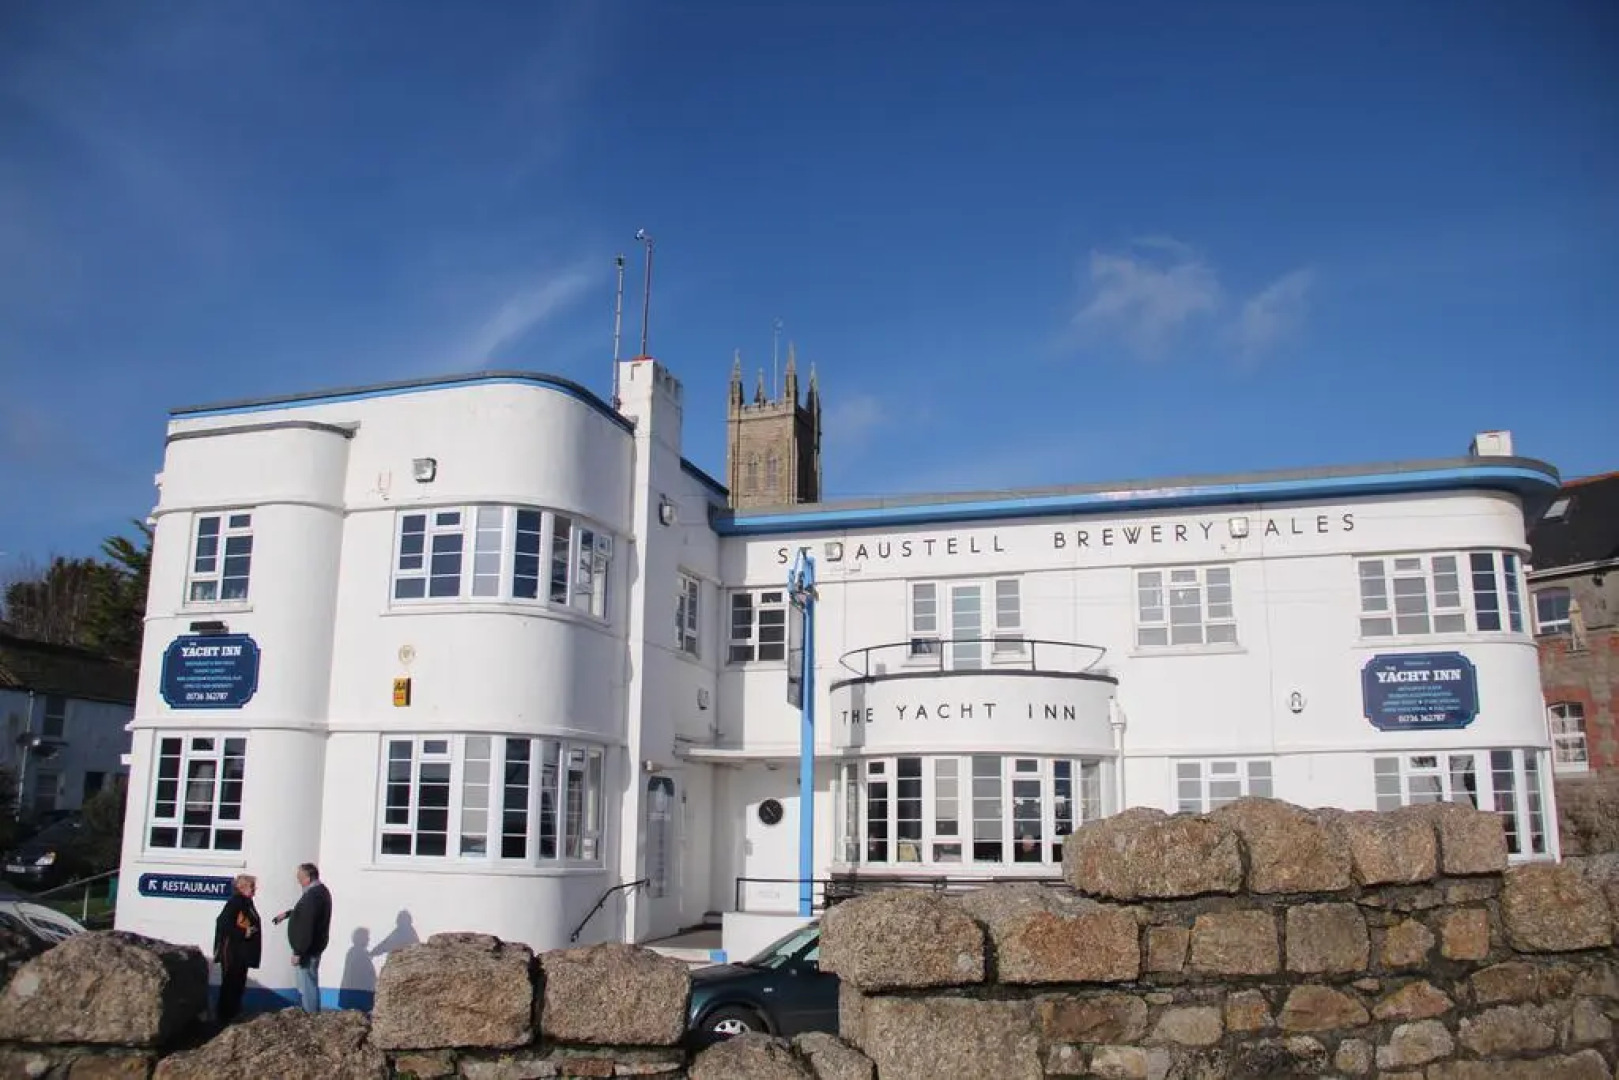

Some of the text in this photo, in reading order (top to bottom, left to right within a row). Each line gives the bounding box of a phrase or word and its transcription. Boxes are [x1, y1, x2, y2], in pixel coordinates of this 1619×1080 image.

[855, 535, 1005, 560] AUSTELL
[1053, 521, 1213, 549] BREWERY
[1264, 513, 1354, 537] ALES
[181, 645, 242, 657] YACHT INN
[1376, 669, 1462, 683] YACHT INN
[842, 703, 1076, 725] THE YACHT INN
[162, 880, 226, 894] RESTAURANT
